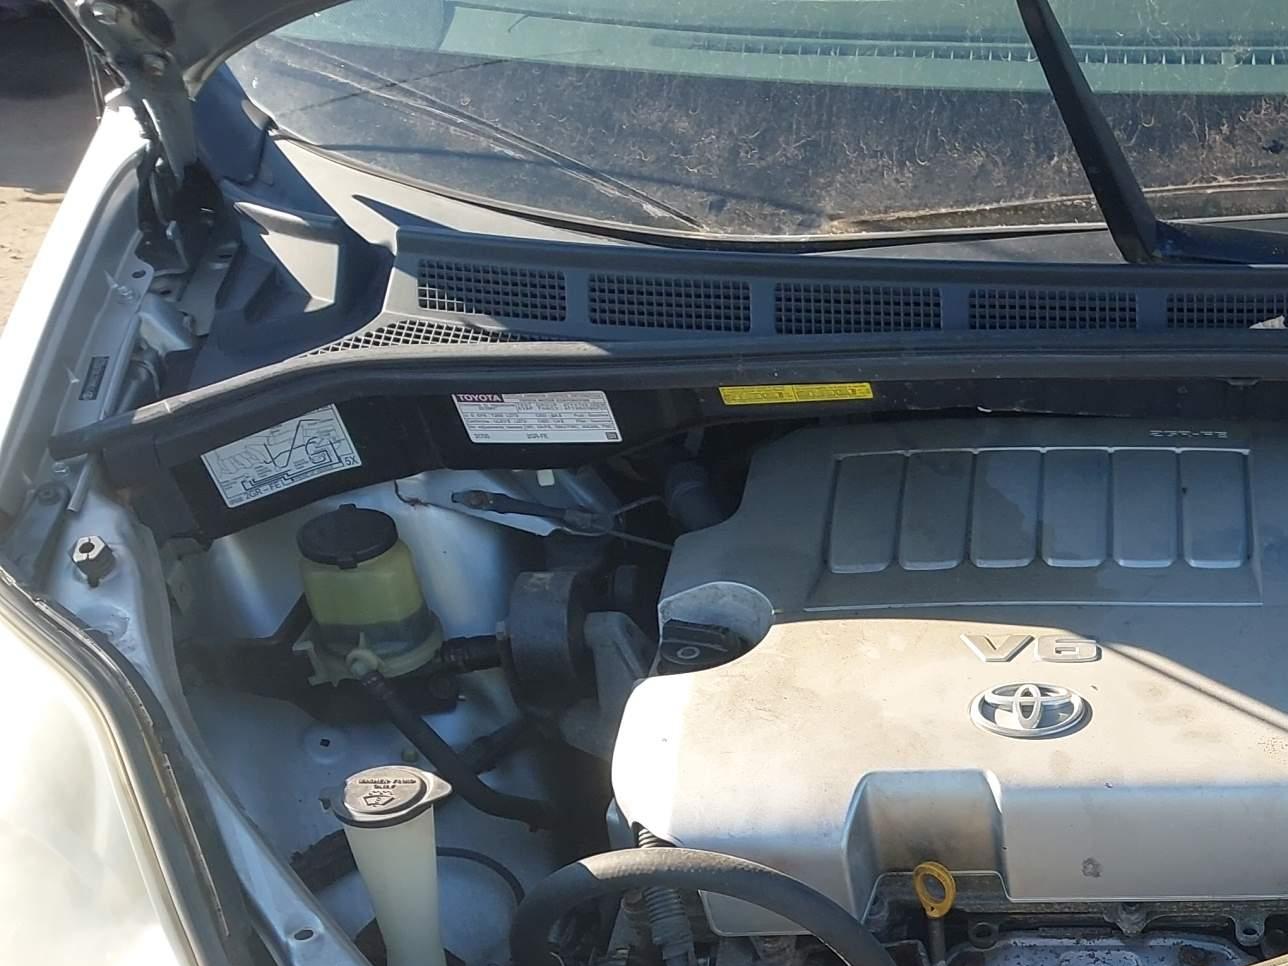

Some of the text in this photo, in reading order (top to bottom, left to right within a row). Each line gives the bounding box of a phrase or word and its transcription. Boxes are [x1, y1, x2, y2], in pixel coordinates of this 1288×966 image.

[457, 393, 502, 402] TOYOTA
[344, 455, 358, 466] 5X
[959, 633, 1103, 663] V6
